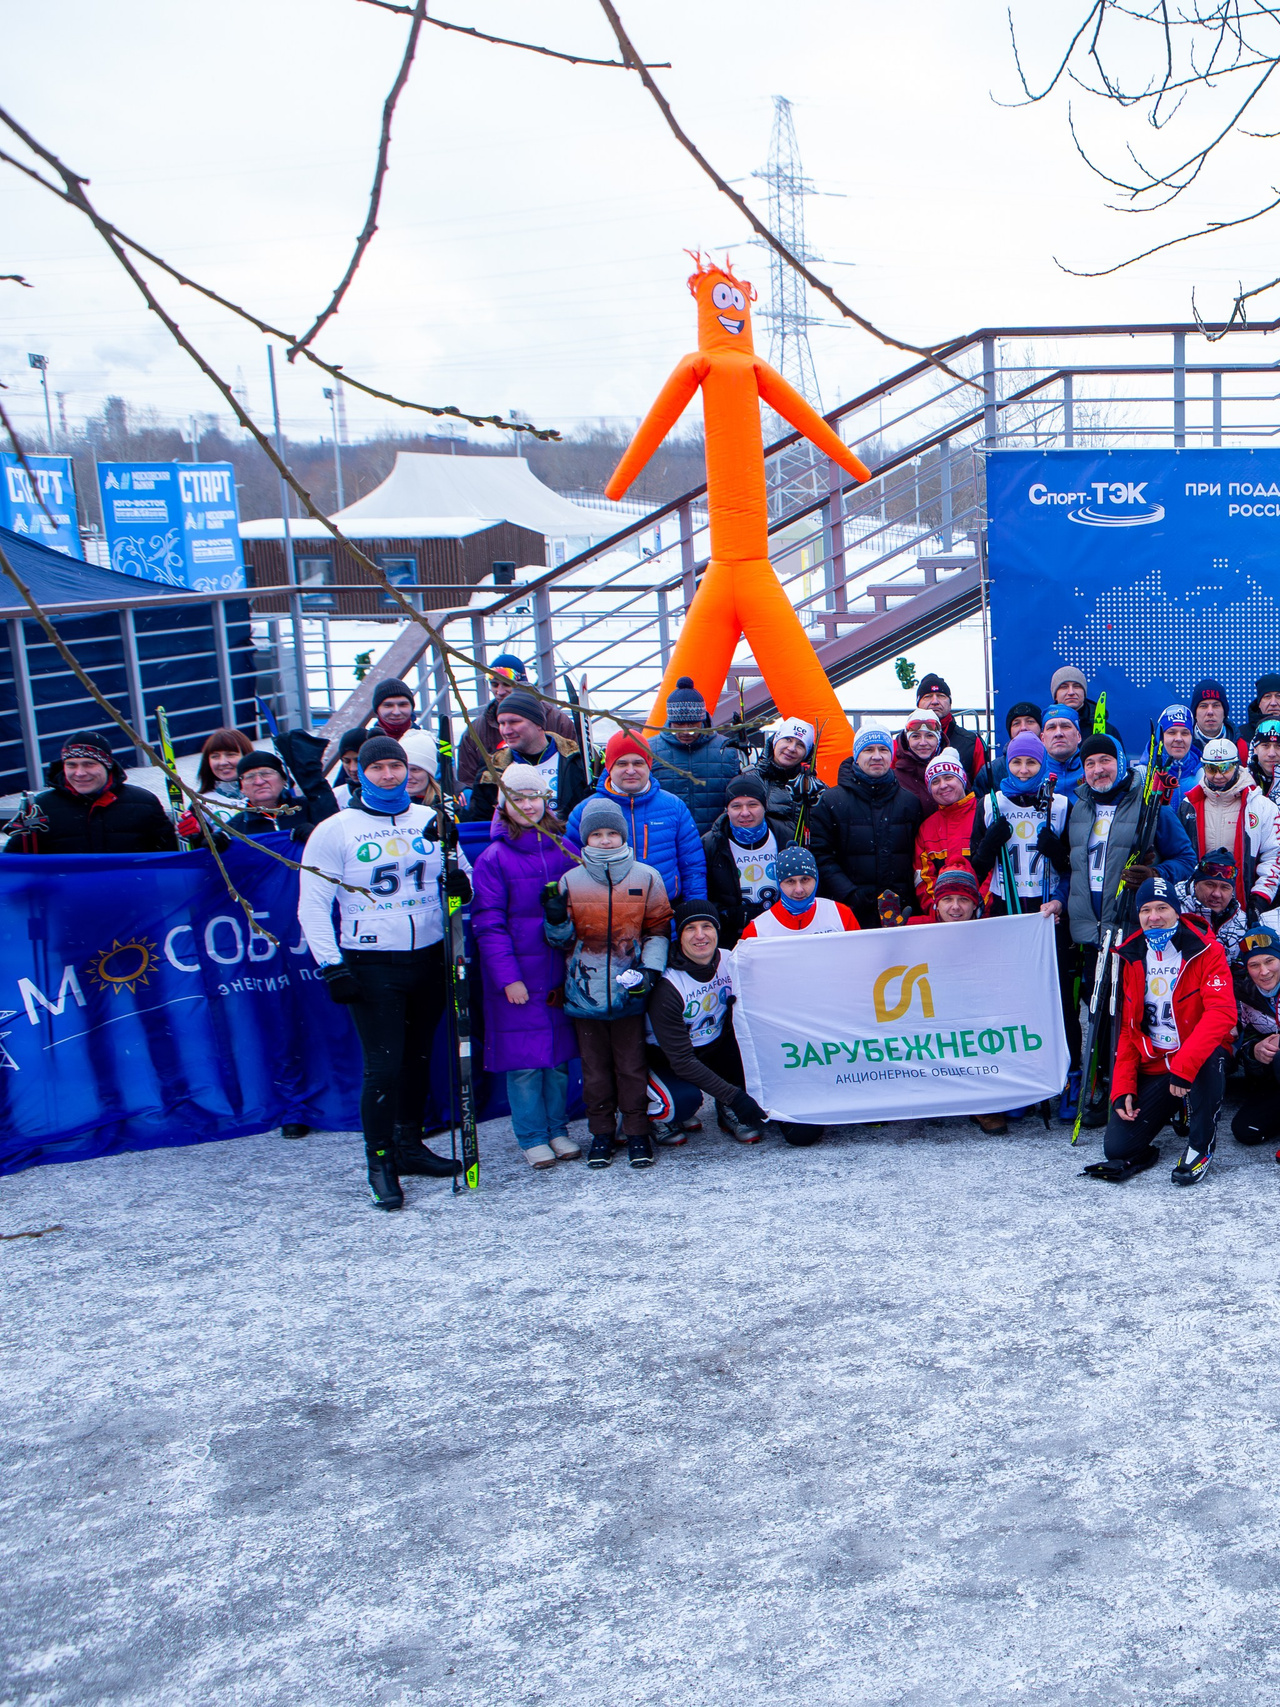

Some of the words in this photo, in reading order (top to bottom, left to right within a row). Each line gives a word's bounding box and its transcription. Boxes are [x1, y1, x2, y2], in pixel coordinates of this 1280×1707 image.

[6, 466, 64, 505] СТАРТ
[179, 470, 231, 503] СТАРТ
[1185, 482, 1221, 496] ПРИ
[1202, 689, 1220, 699] CSKA
[1210, 747, 1228, 756] DNB
[354, 827, 424, 843] VMARAFON
[1007, 843, 1044, 876] 17
[369, 859, 427, 898] 51
[1154, 877, 1168, 898] PUM
[780, 1024, 1043, 1069] ЗАРУБЕЖНЕФТЬ
[835, 1068, 927, 1085] АКЦИОНЕРНОЕ
[931, 1065, 1000, 1078] ОБЩЕСТВО
